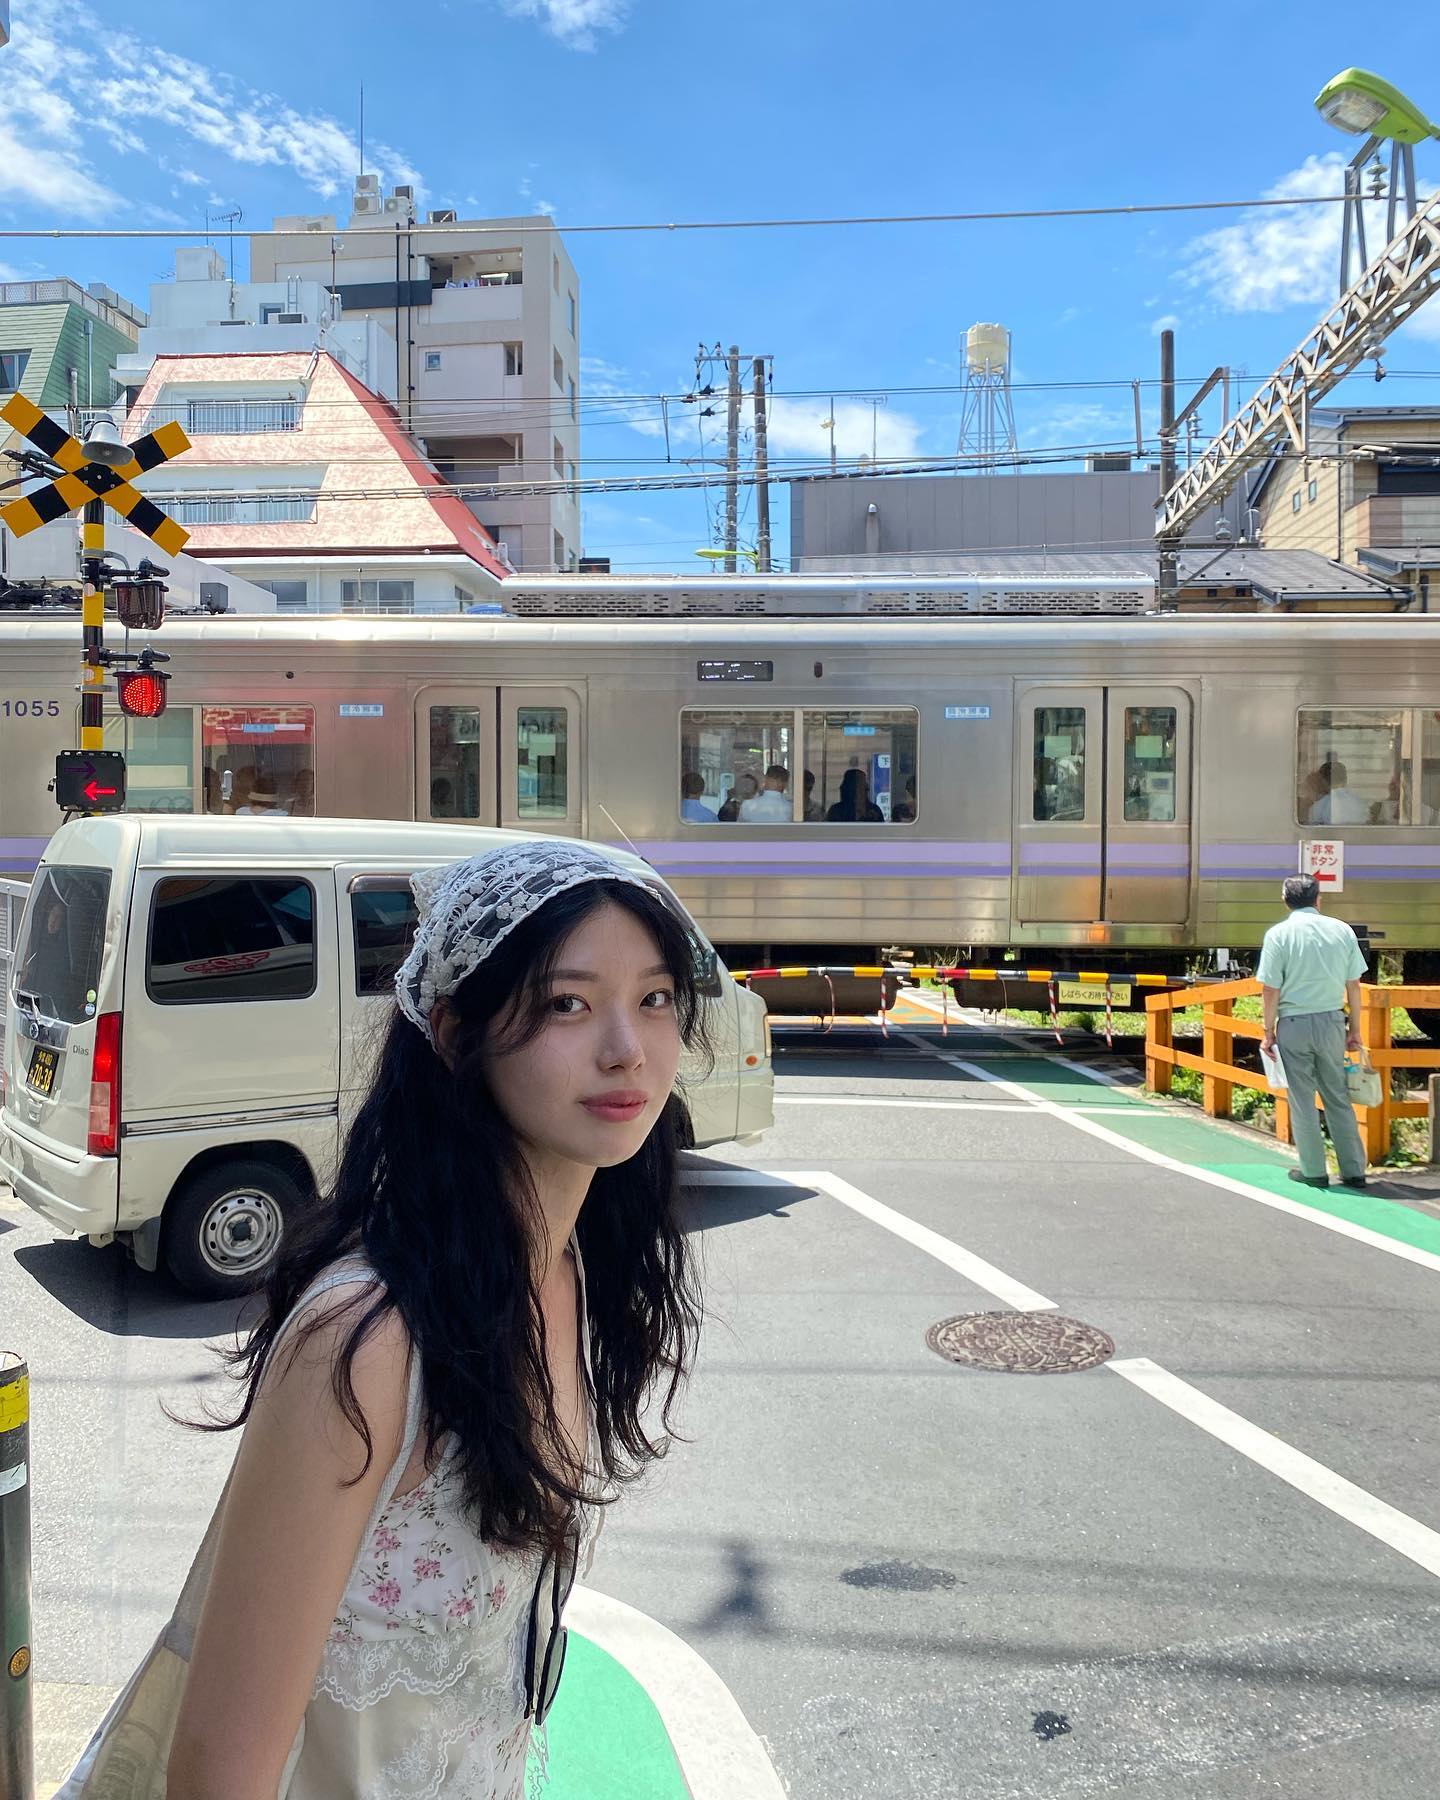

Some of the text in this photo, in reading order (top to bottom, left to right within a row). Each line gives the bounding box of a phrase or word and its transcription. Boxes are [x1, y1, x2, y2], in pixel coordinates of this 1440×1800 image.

[2, 700, 60, 717] 1055
[1312, 844, 1335, 855] 非常
[1311, 856, 1337, 866] ボタン
[73, 1045, 89, 1056] Dias
